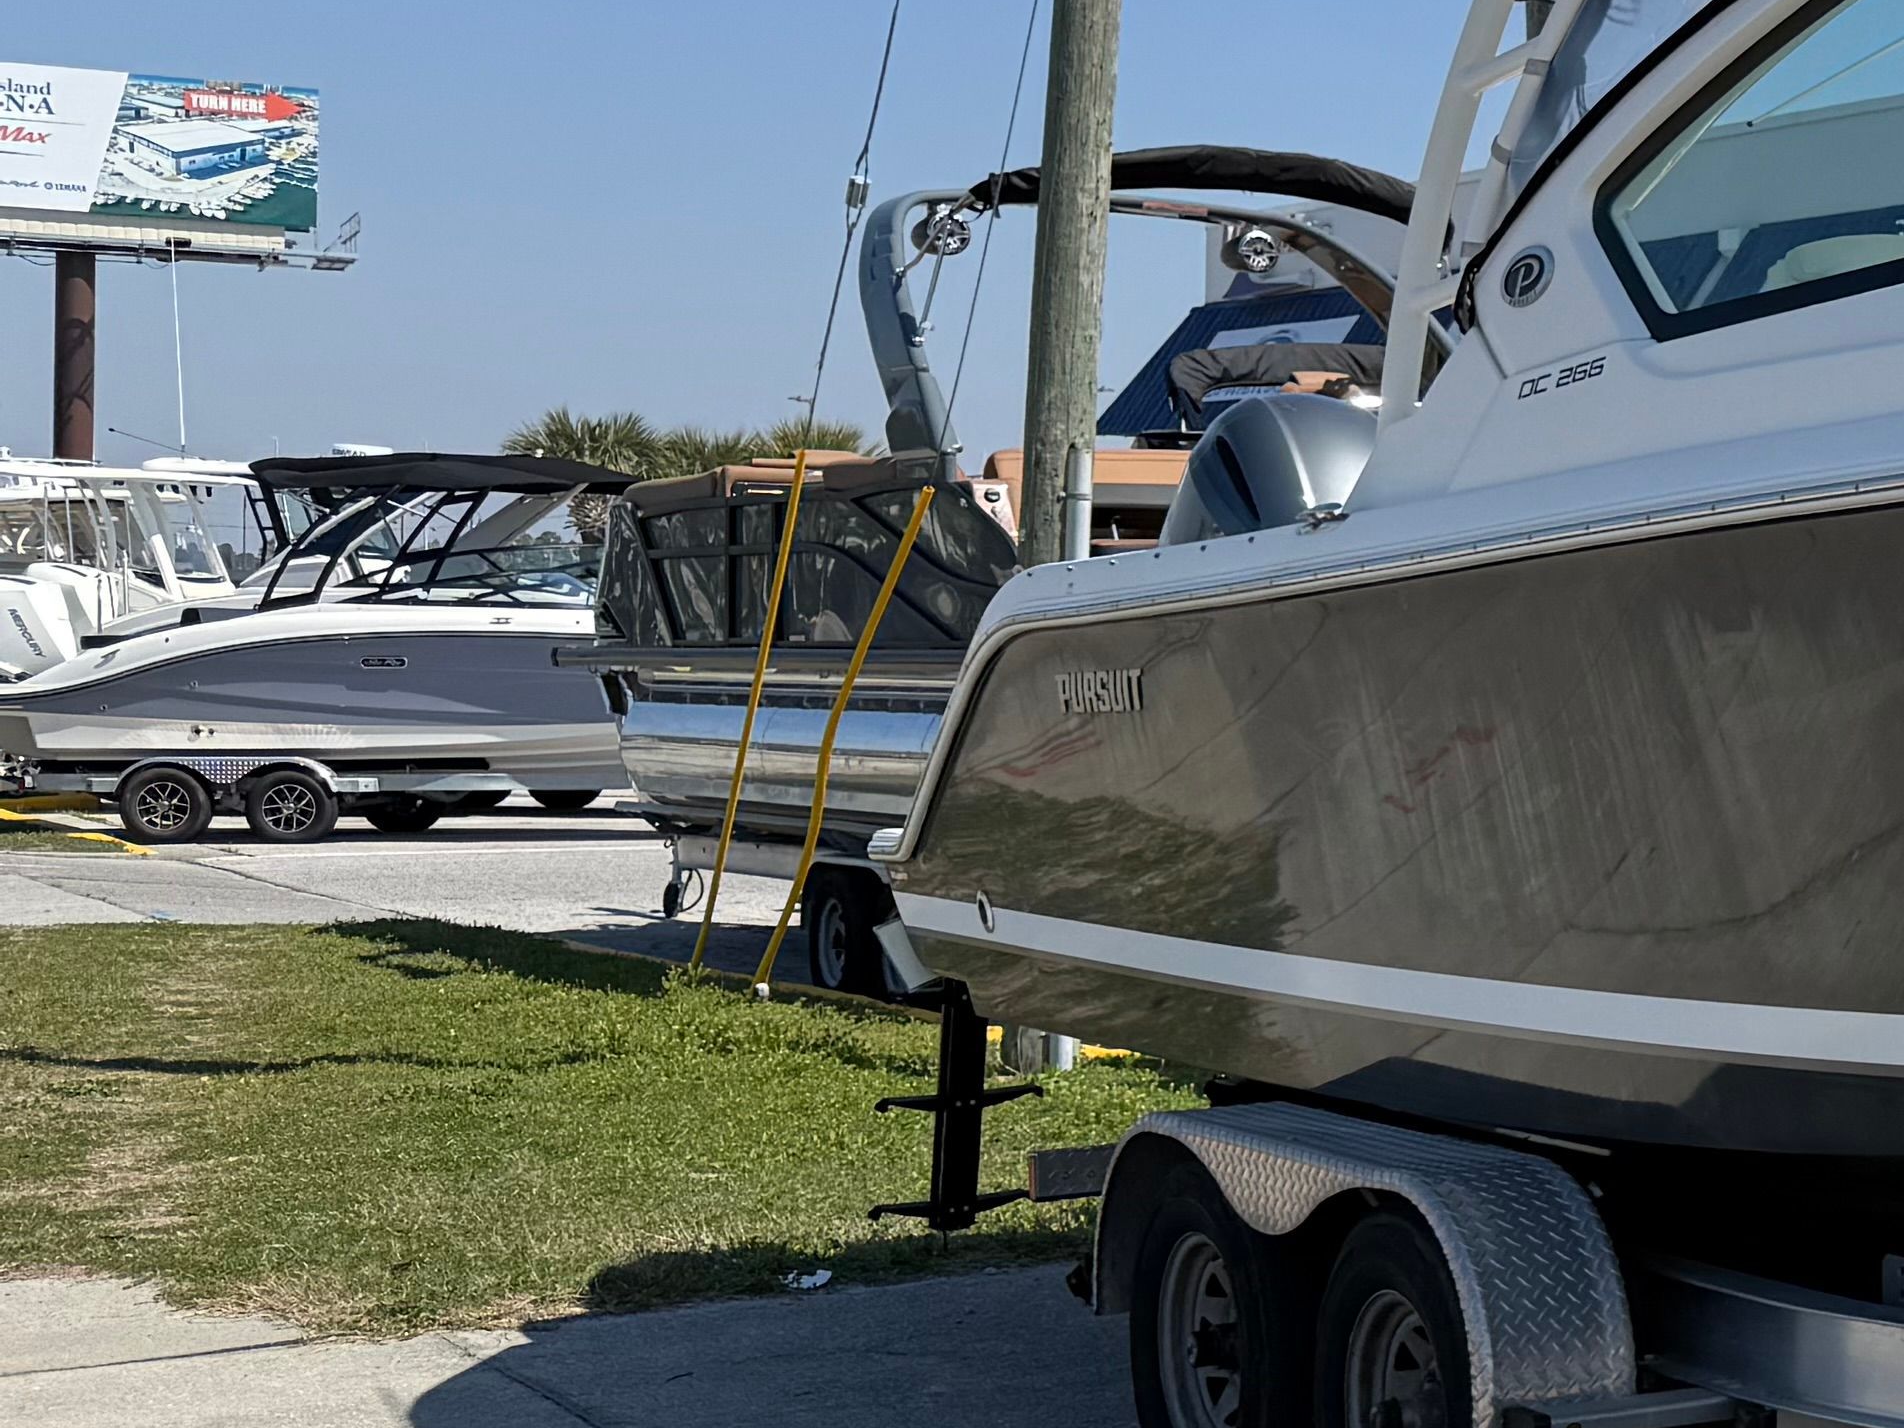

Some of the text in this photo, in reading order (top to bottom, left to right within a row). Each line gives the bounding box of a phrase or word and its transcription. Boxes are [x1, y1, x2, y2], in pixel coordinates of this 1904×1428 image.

[190, 92, 266, 114] TURN HERE
[1556, 356, 1607, 388] 266
[1055, 668, 1143, 714] PURSUIT
